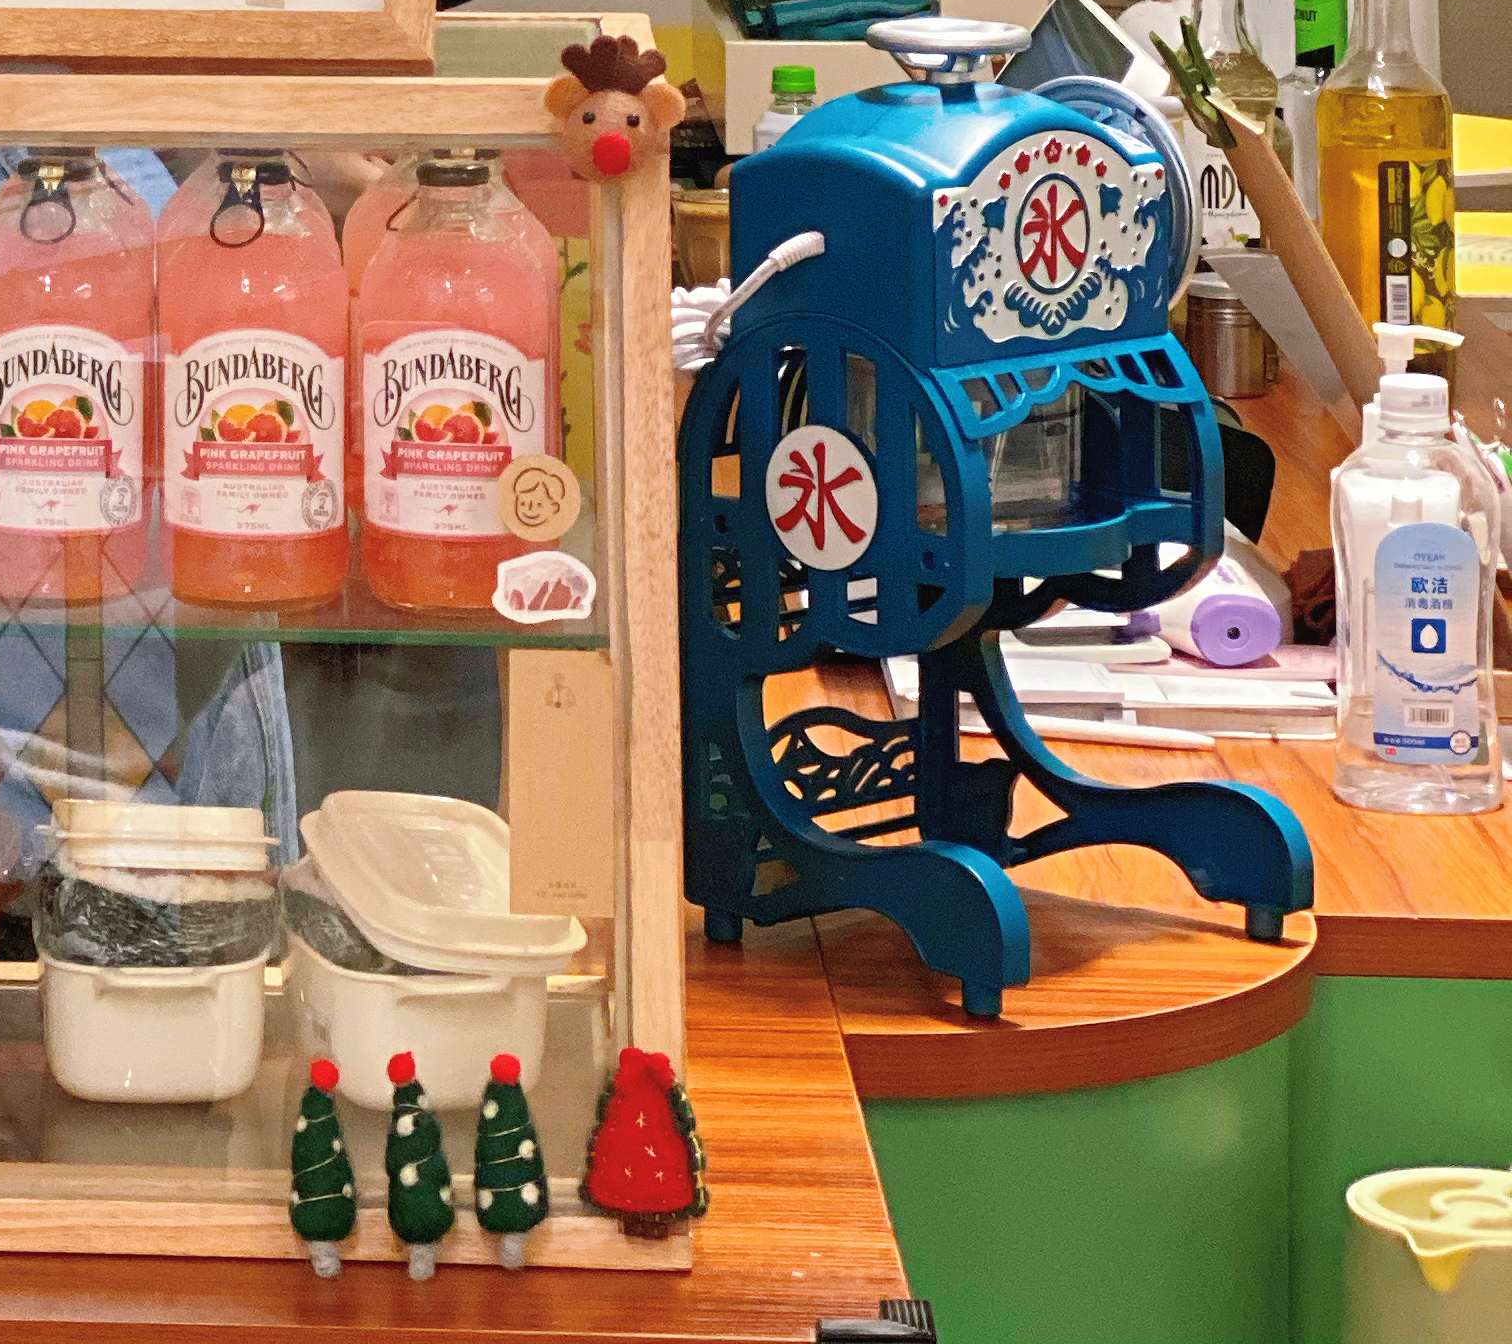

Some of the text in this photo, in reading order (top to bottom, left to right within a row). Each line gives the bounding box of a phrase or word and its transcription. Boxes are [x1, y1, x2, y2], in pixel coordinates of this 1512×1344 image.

[1019, 183, 1088, 284] 氷
[175, 345, 335, 430] BUNDABERG
[373, 346, 535, 432] BUNDABERG
[0, 445, 105, 456] PINK GRAPEFRUIT
[199, 449, 306, 461] PINK GRAPEFRUIT
[397, 448, 504, 462] PINK GRAPEFRUIT
[5, 459, 99, 467] SPARKLING DRINK
[206, 462, 301, 472] SPARKLING DRINK
[403, 462, 462, 472] SPARKLING
[775, 442, 868, 551] 氷
[1411, 577, 1448, 594] 欧洁
